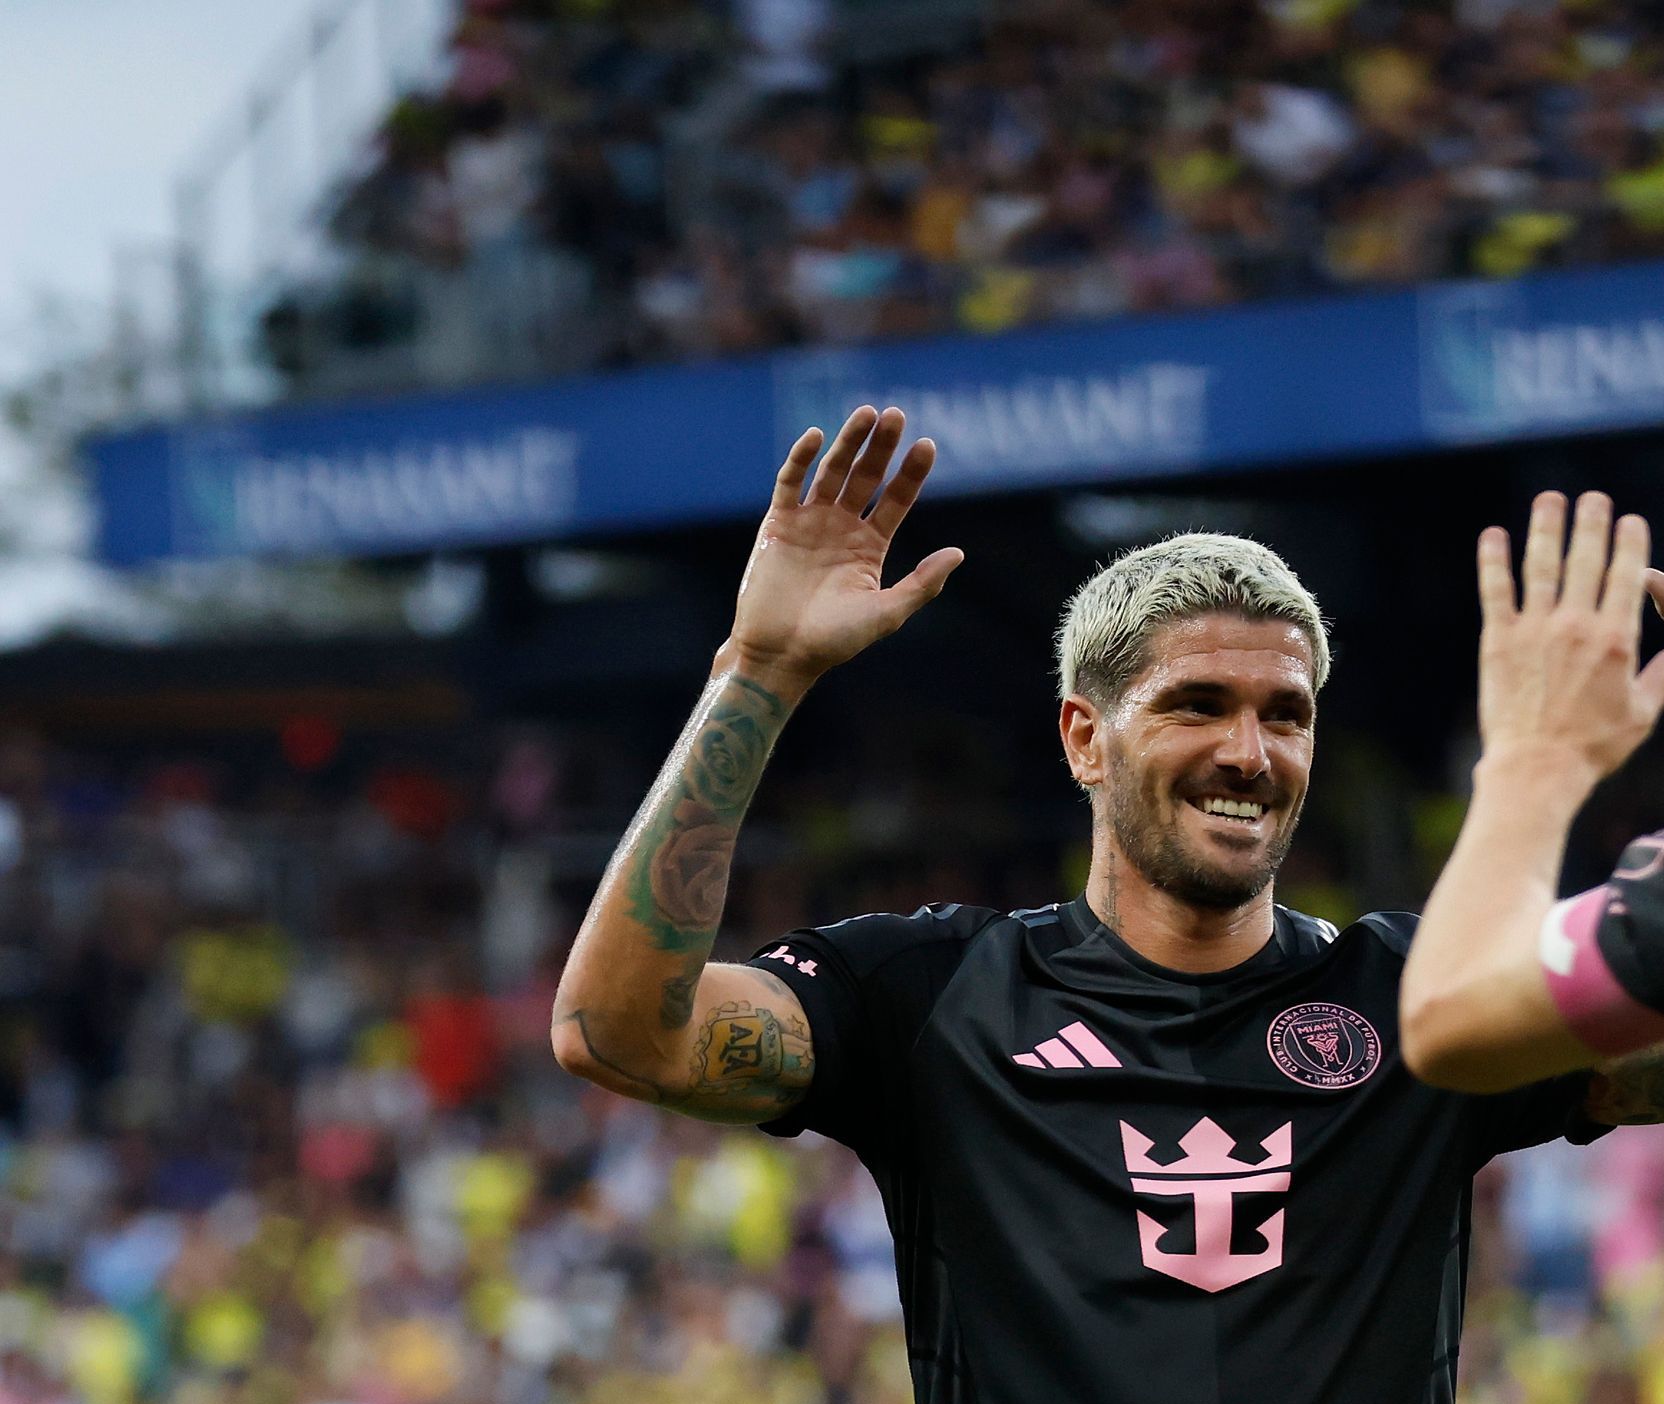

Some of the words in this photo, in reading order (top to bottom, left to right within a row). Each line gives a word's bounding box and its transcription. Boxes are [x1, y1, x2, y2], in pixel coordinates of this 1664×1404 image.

[1272, 1006, 1344, 1047] INTERNACIONAL
[1349, 1015, 1362, 1026] DE
[1297, 1022, 1338, 1034] MIAMI
[1322, 1074, 1356, 1084] MMXX
